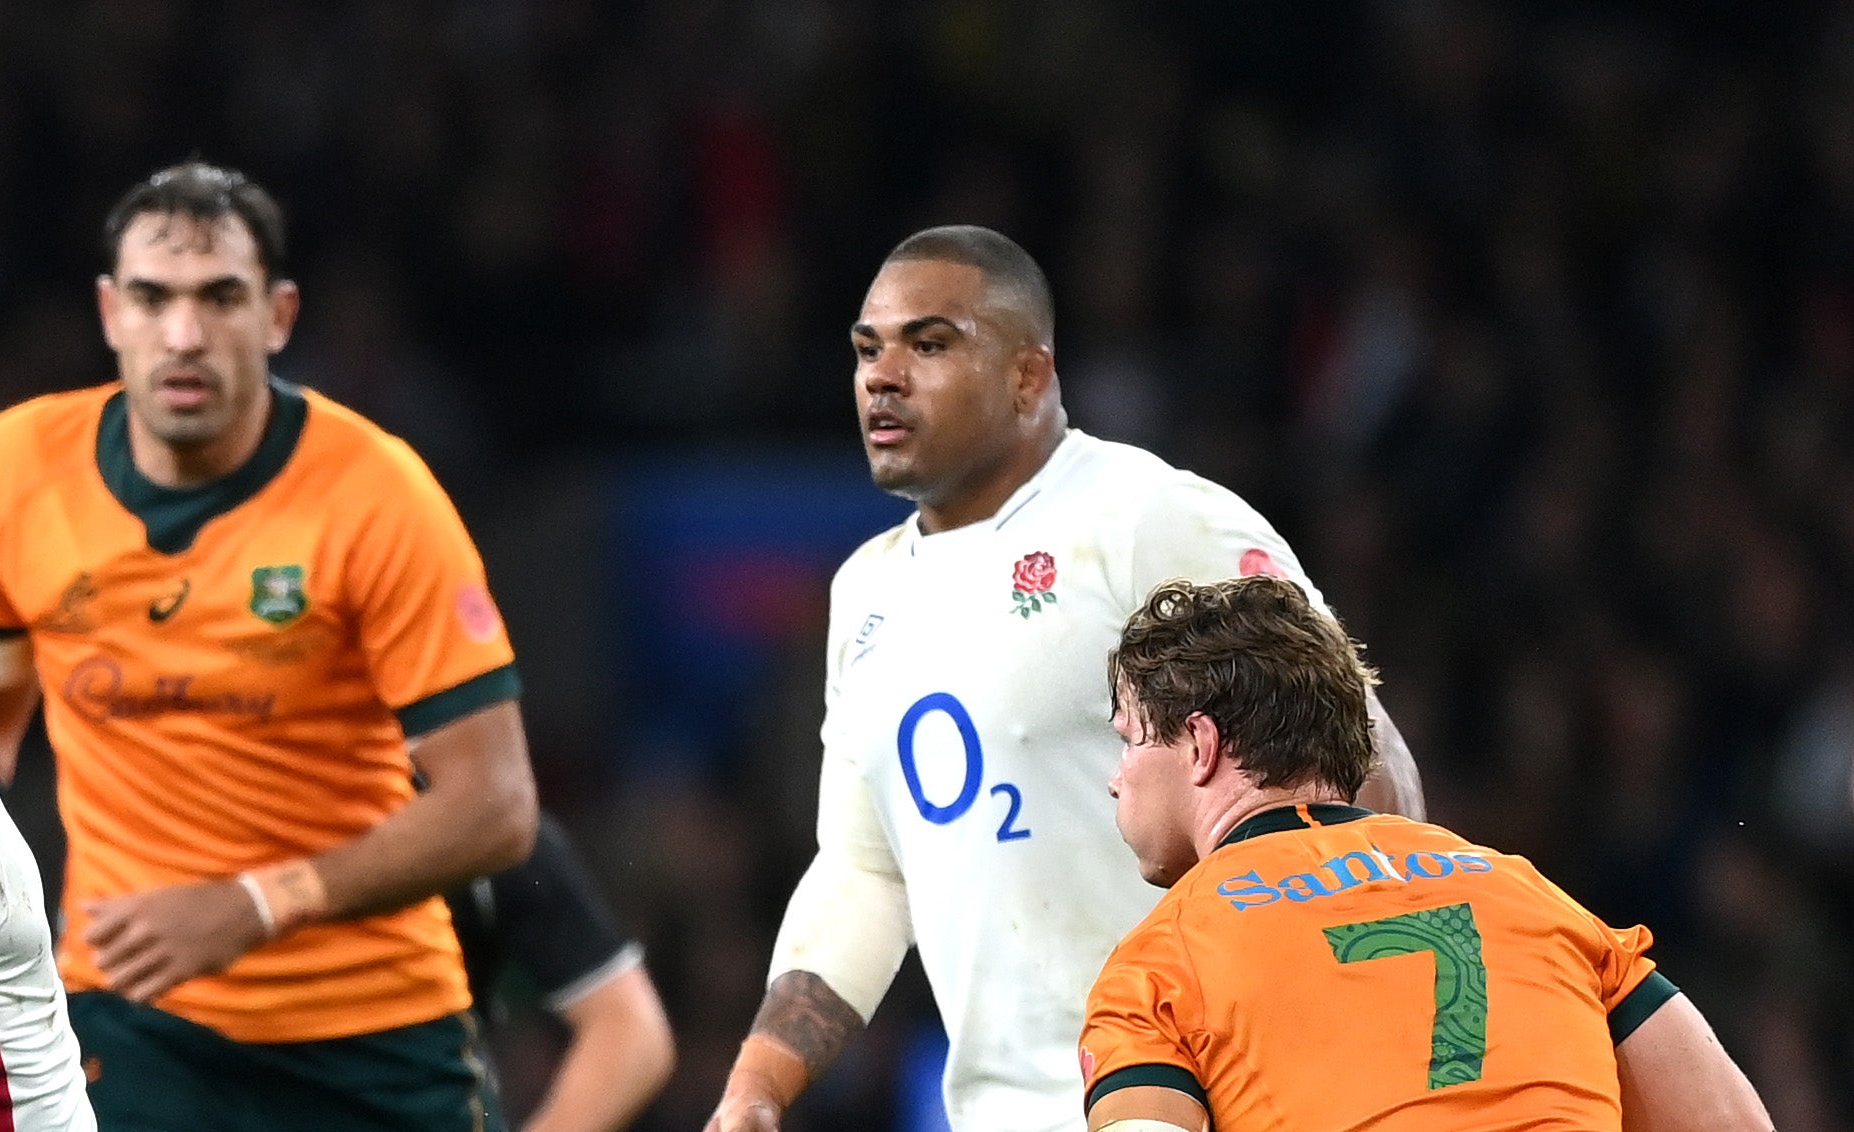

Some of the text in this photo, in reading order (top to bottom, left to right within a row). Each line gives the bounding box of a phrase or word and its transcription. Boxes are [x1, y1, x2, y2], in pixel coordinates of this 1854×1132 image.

[897, 691, 1032, 842] O2
[1217, 845, 1493, 912] Santos
[1322, 902, 1488, 1091] 7
